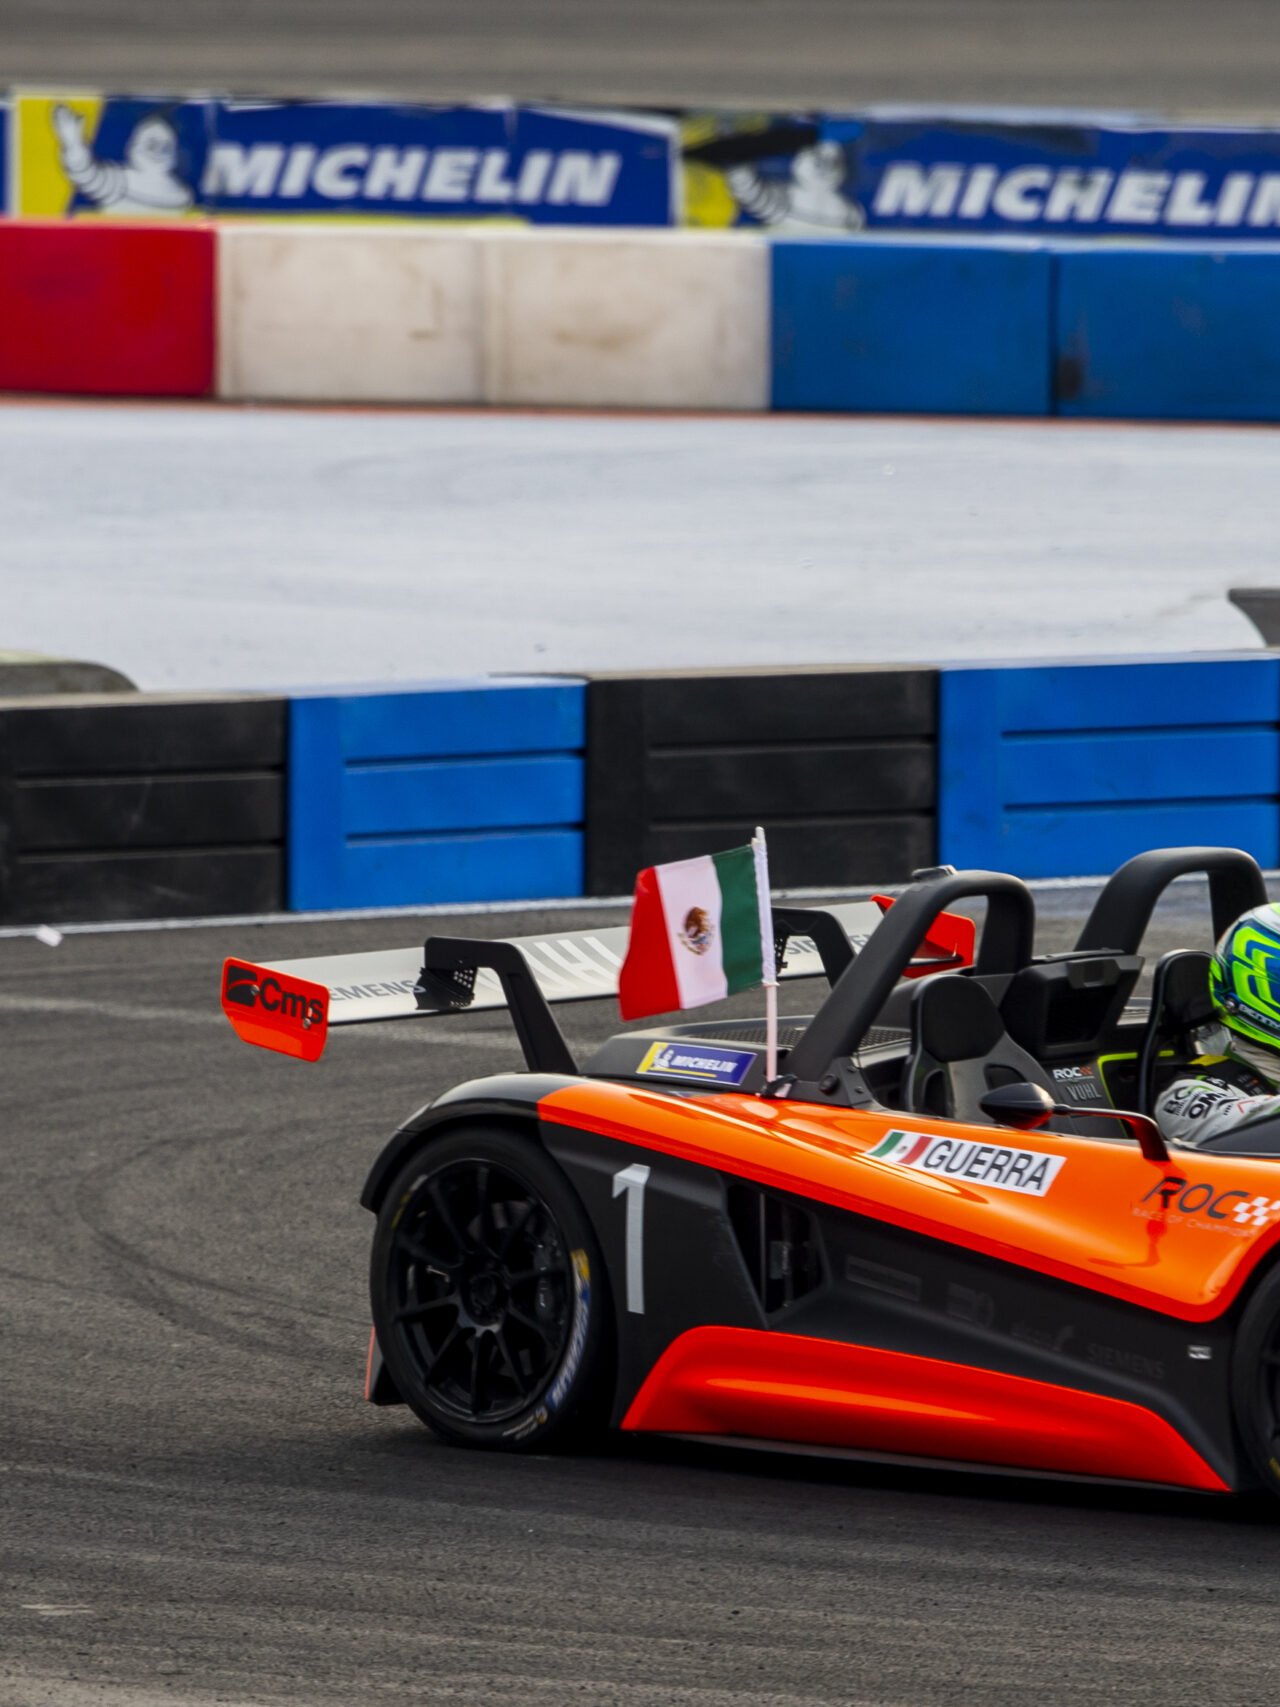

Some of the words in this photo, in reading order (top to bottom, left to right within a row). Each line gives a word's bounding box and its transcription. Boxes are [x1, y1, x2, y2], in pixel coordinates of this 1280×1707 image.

[204, 143, 621, 206] MICHELIN
[259, 977, 324, 1025] Cms
[330, 979, 426, 1002] EMENS
[670, 1055, 738, 1073] MICHELIN
[1052, 1066, 1083, 1079] ROC
[923, 1139, 1051, 1192] GUERRA
[1141, 1176, 1250, 1220] ROC
[612, 1163, 650, 1315] 1
